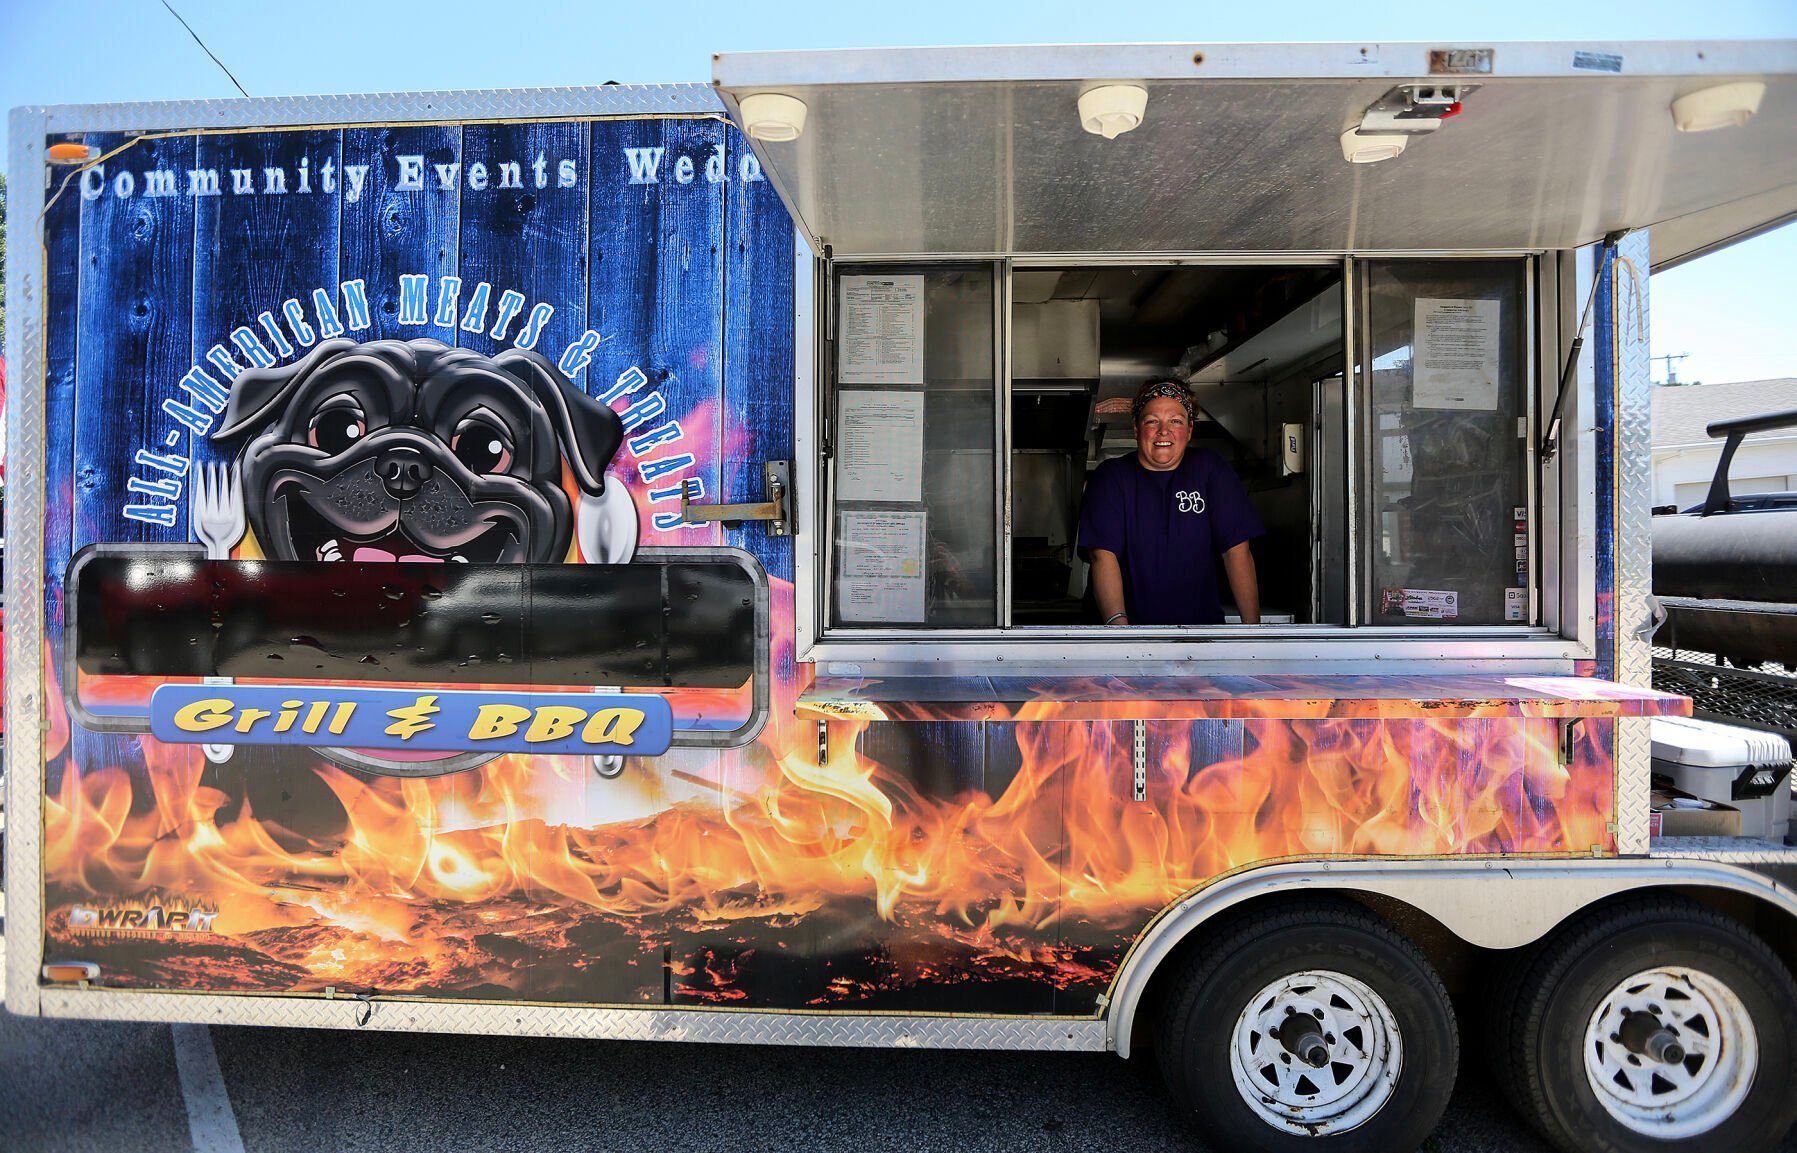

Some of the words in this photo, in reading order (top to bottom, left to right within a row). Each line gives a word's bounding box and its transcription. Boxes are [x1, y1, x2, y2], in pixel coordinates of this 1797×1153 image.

[80, 156, 370, 203] Community
[394, 151, 577, 191] Events
[123, 279, 371, 527] ALL-AMERICAN
[398, 274, 554, 350] MEATS
[558, 329, 600, 379] &
[596, 366, 710, 531] TREATS
[1175, 490, 1206, 514] BB
[173, 698, 357, 735] Grill
[384, 695, 442, 741] &
[469, 703, 647, 746] BBQ
